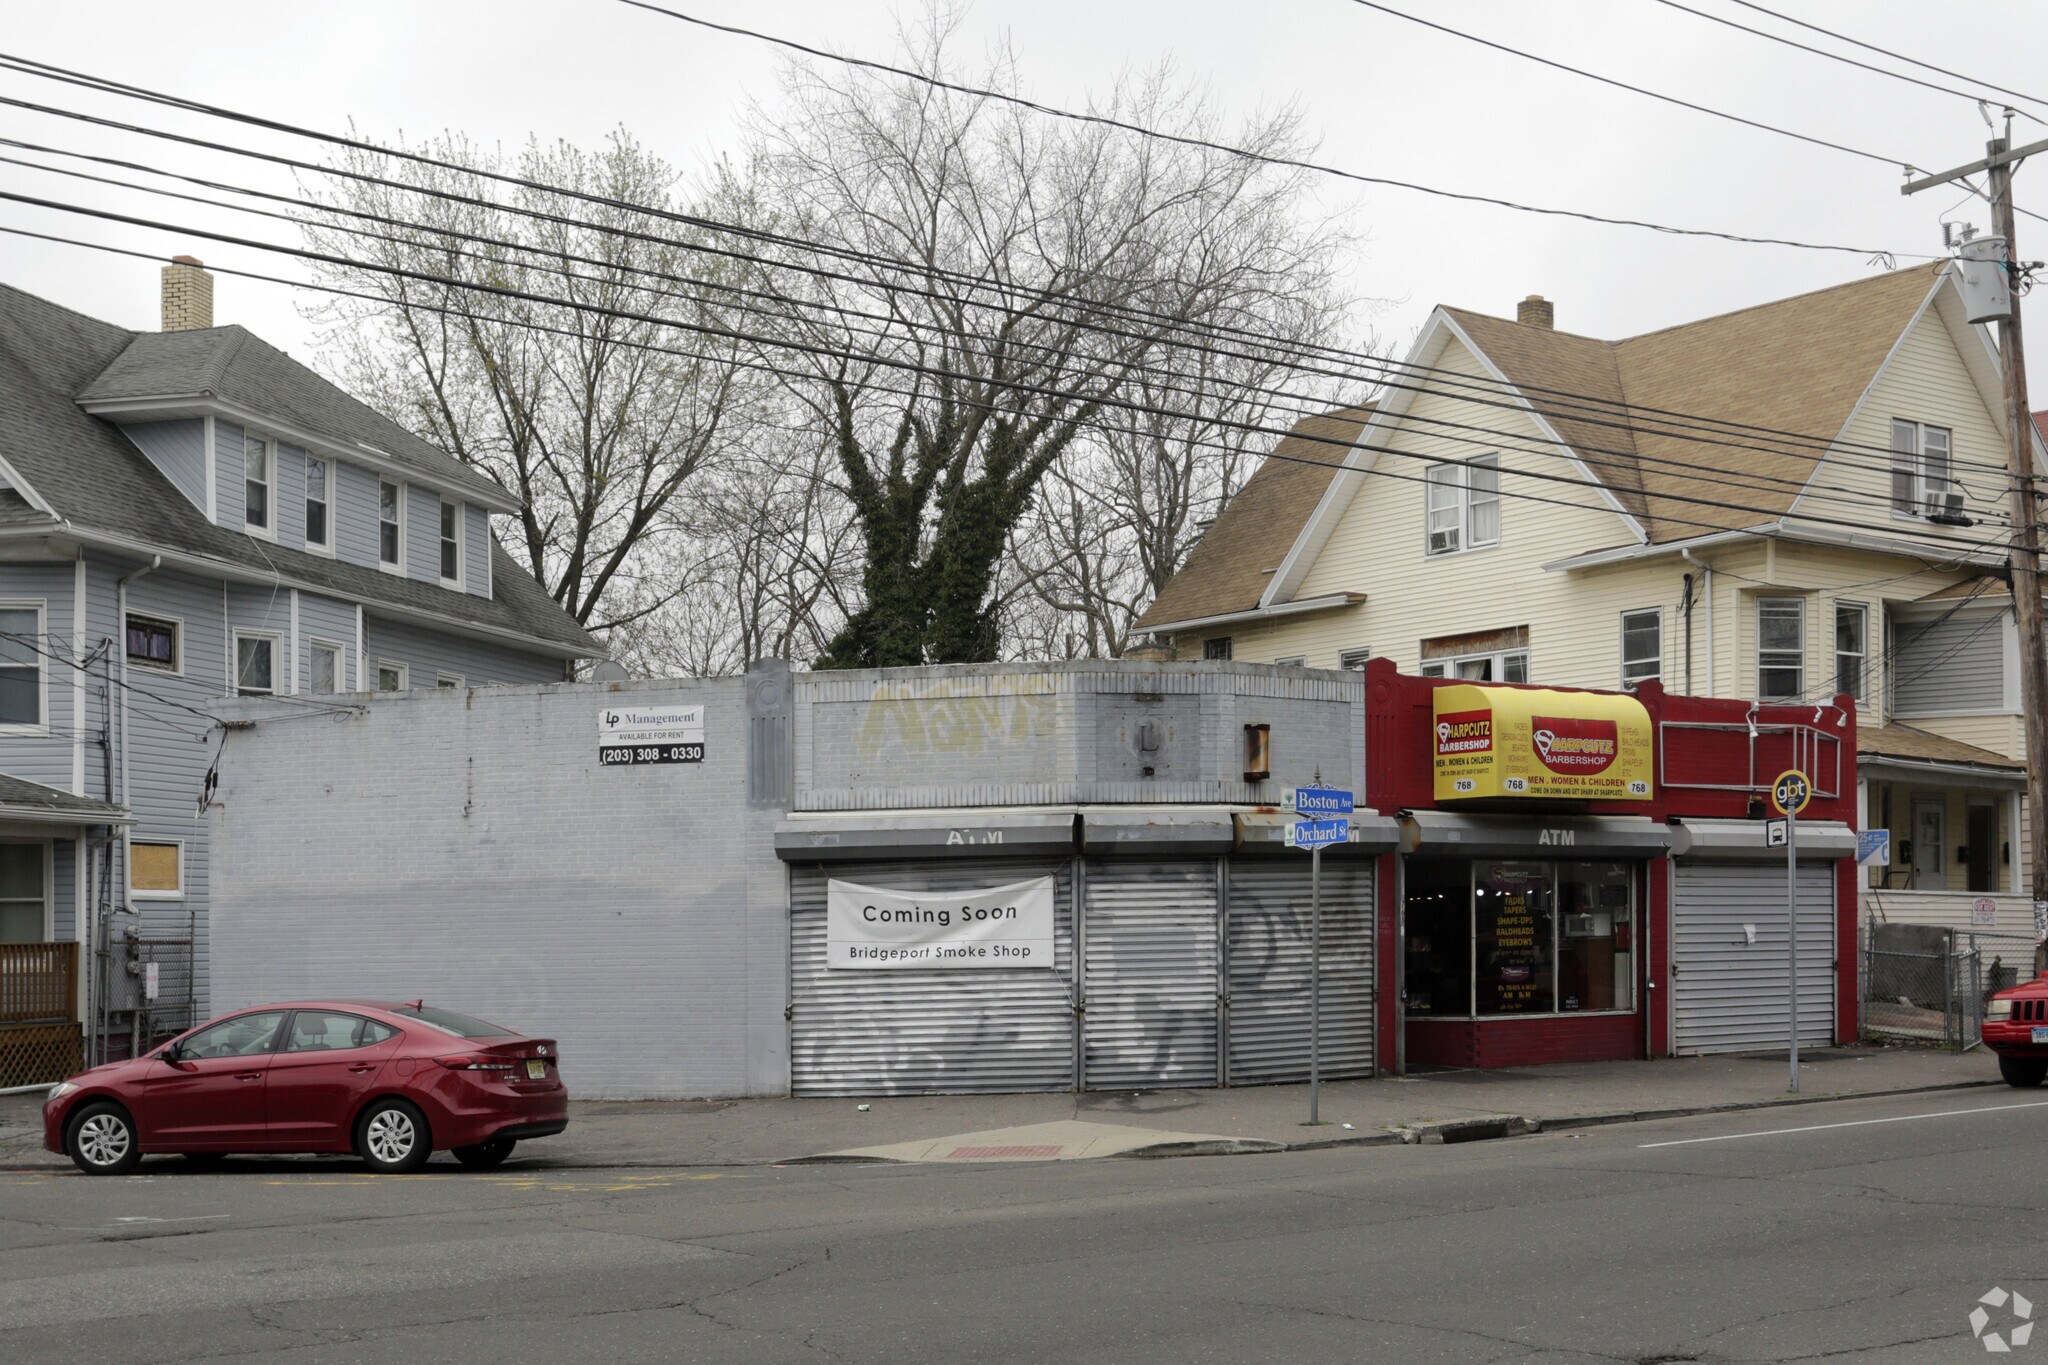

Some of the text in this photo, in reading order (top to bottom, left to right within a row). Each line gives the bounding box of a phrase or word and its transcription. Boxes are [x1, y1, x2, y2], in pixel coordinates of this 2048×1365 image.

[625, 712, 695, 726] Management
[619, 731, 685, 741] AVAILABLE FOR RENT
[1440, 739, 1490, 753] BARBERSHOP
[602, 748, 634, 765] (203)
[637, 747, 660, 761] 308
[671, 746, 701, 760] 0330
[1546, 755, 1607, 765] BARBERSHOP
[1436, 759, 1446, 768] MEN
[1449, 757, 1466, 766] WOMEN
[1466, 757, 1470, 765] &
[1470, 756, 1494, 765] CHILDREN
[1456, 781, 1472, 790] 768
[1508, 779, 1523, 790] 768
[1527, 775, 1545, 785] MEN
[1550, 776, 1579, 786] WOMEN
[1580, 777, 1586, 786] &
[1588, 778, 1626, 787] CHILDREN
[1580, 788, 1594, 796] SHARP
[1631, 783, 1646, 793] 768
[1776, 779, 1805, 803] gbt
[1298, 791, 1339, 810] Boston
[1340, 798, 1352, 808] Ave
[1296, 822, 1337, 842] Orchard
[1339, 825, 1347, 836] St
[1538, 829, 1576, 846] ATM
[1505, 896, 1525, 905] FADES
[863, 905, 1018, 926] Coming Soon
[1503, 906, 1527, 914] TAPERS
[1497, 916, 1533, 926] SHAPE-UPS
[1496, 927, 1535, 936] BALDHEADS
[1498, 938, 1533, 947] EYEBROWS
[850, 945, 1031, 961] Bridgeport Smoke Shop
